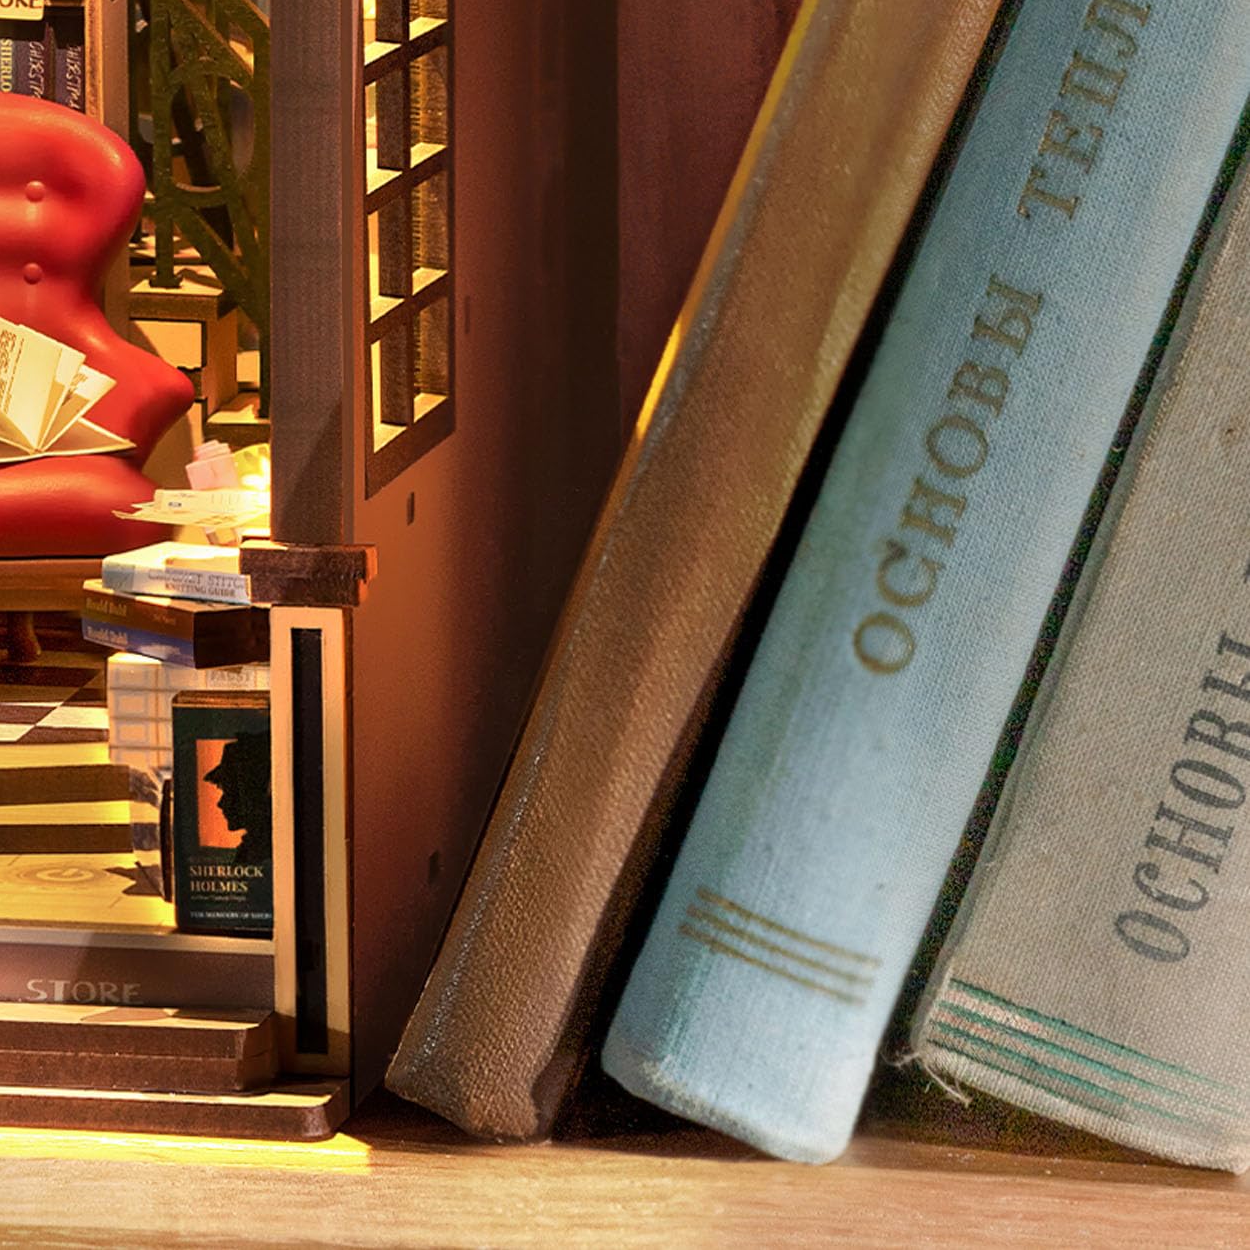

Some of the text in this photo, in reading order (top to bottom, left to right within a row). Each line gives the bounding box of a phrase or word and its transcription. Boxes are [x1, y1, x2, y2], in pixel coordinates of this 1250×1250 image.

[852, 272, 1044, 677] ОСНОВЫ
[190, 864, 264, 878] SHERLOCK
[190, 880, 249, 892] HOLMES
[25, 978, 144, 1006] STORE
